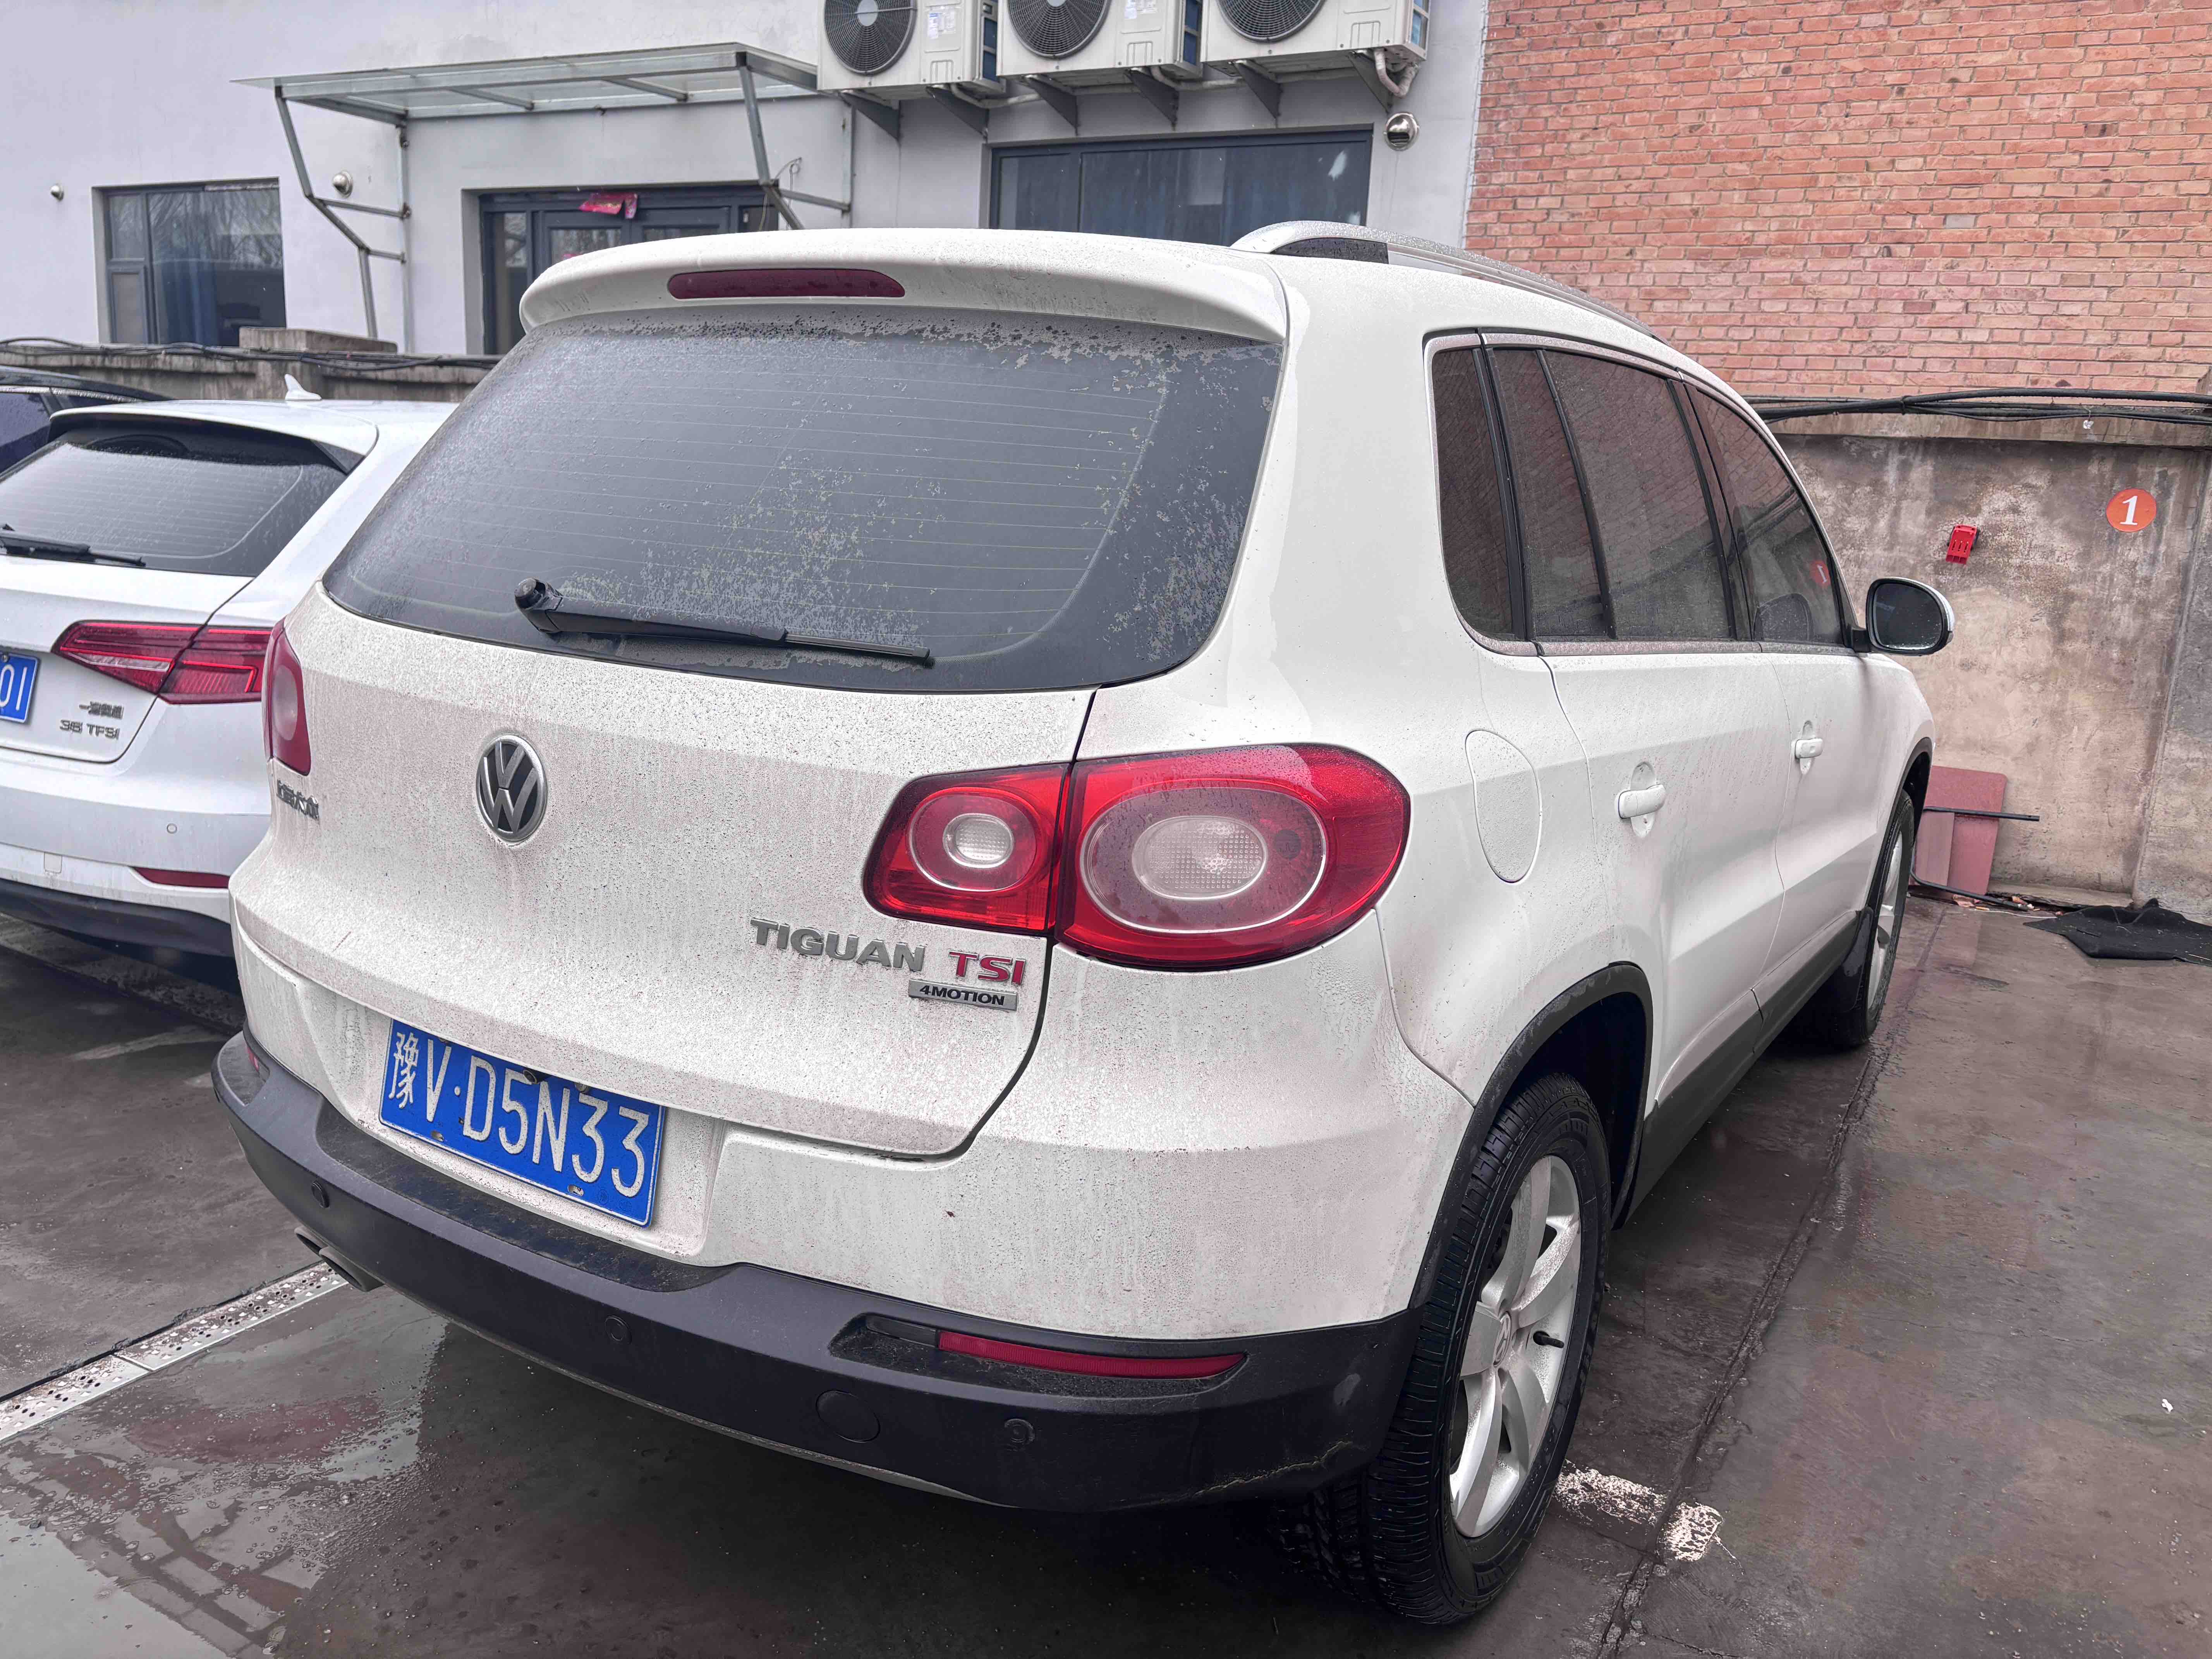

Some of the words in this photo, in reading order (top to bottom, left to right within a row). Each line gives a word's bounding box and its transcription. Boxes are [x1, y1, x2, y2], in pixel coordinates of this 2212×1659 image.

[2120, 495, 2138, 526] 1
[86, 723, 120, 740] TFSI
[479, 739, 542, 834] VW
[750, 917, 926, 972] TIGUAN
[949, 949, 1027, 986] TSI
[919, 985, 1005, 1006] 4MOTION
